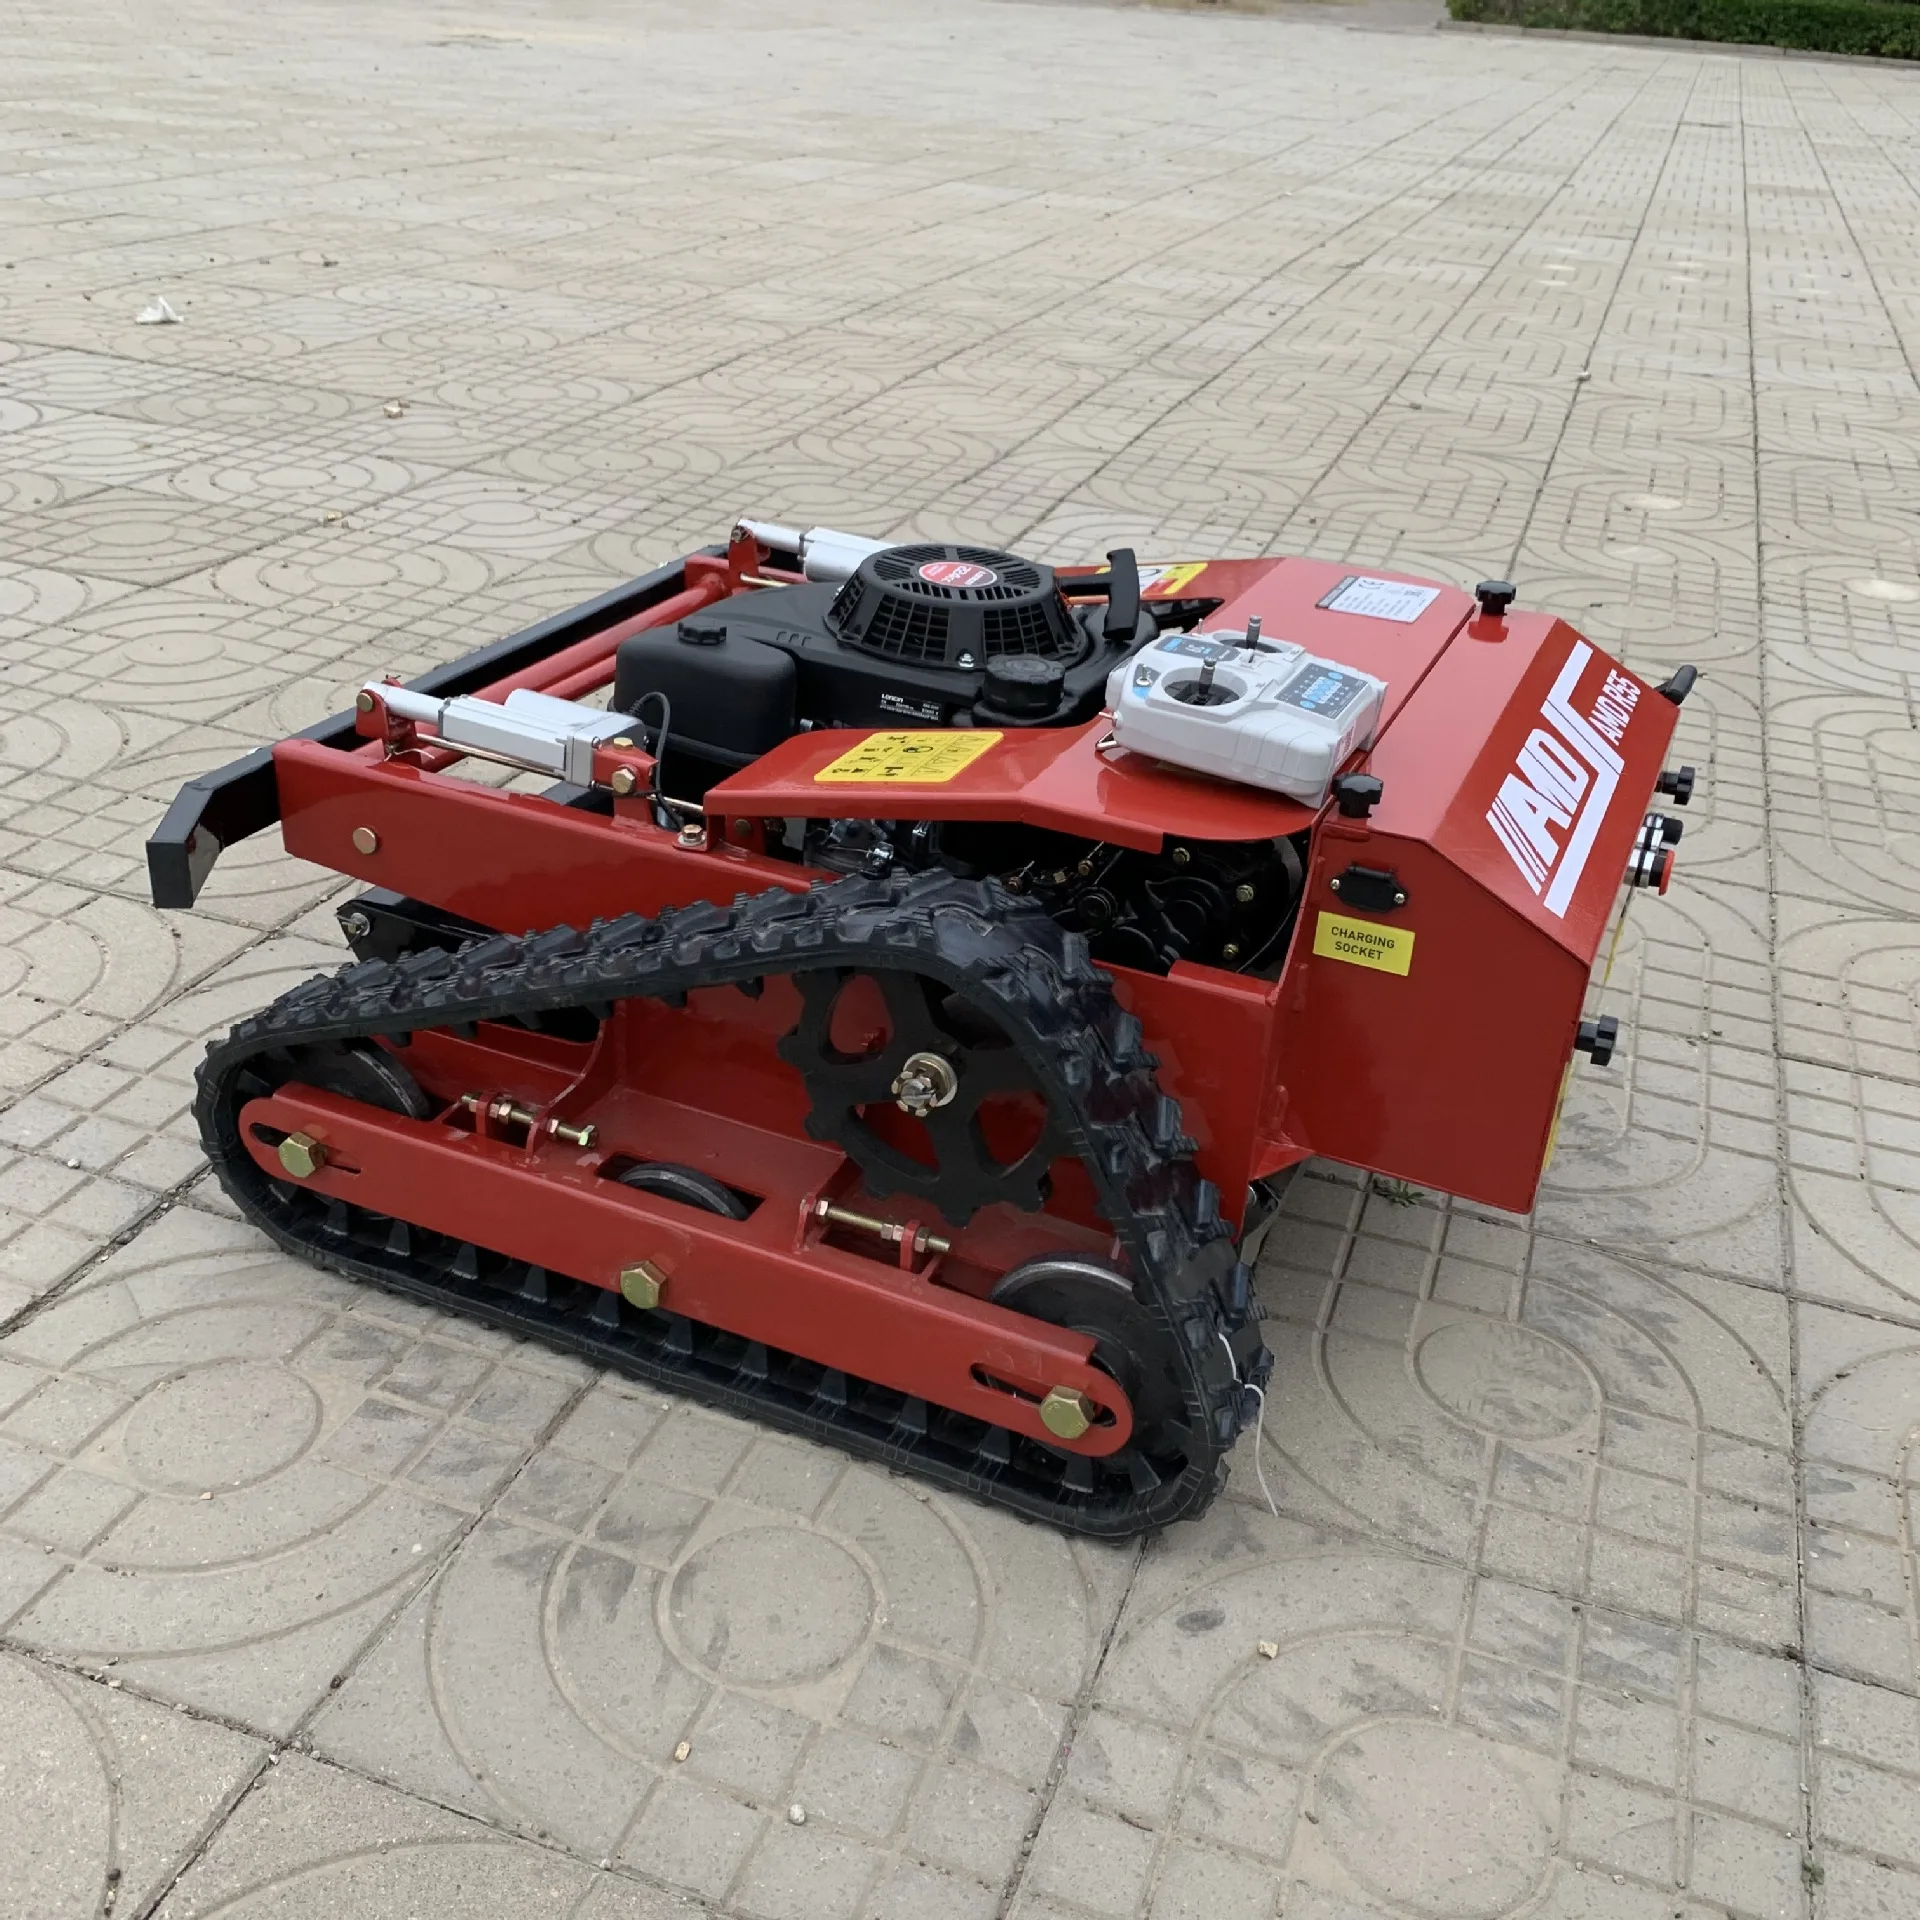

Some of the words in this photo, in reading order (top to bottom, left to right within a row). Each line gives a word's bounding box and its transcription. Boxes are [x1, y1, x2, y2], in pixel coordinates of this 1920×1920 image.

[1602, 668, 1641, 712] R55
[1588, 693, 1630, 746] AMD
[1496, 728, 1590, 868] AMD
[1331, 926, 1395, 949] CHARGING
[1334, 941, 1384, 960] SOCKET
